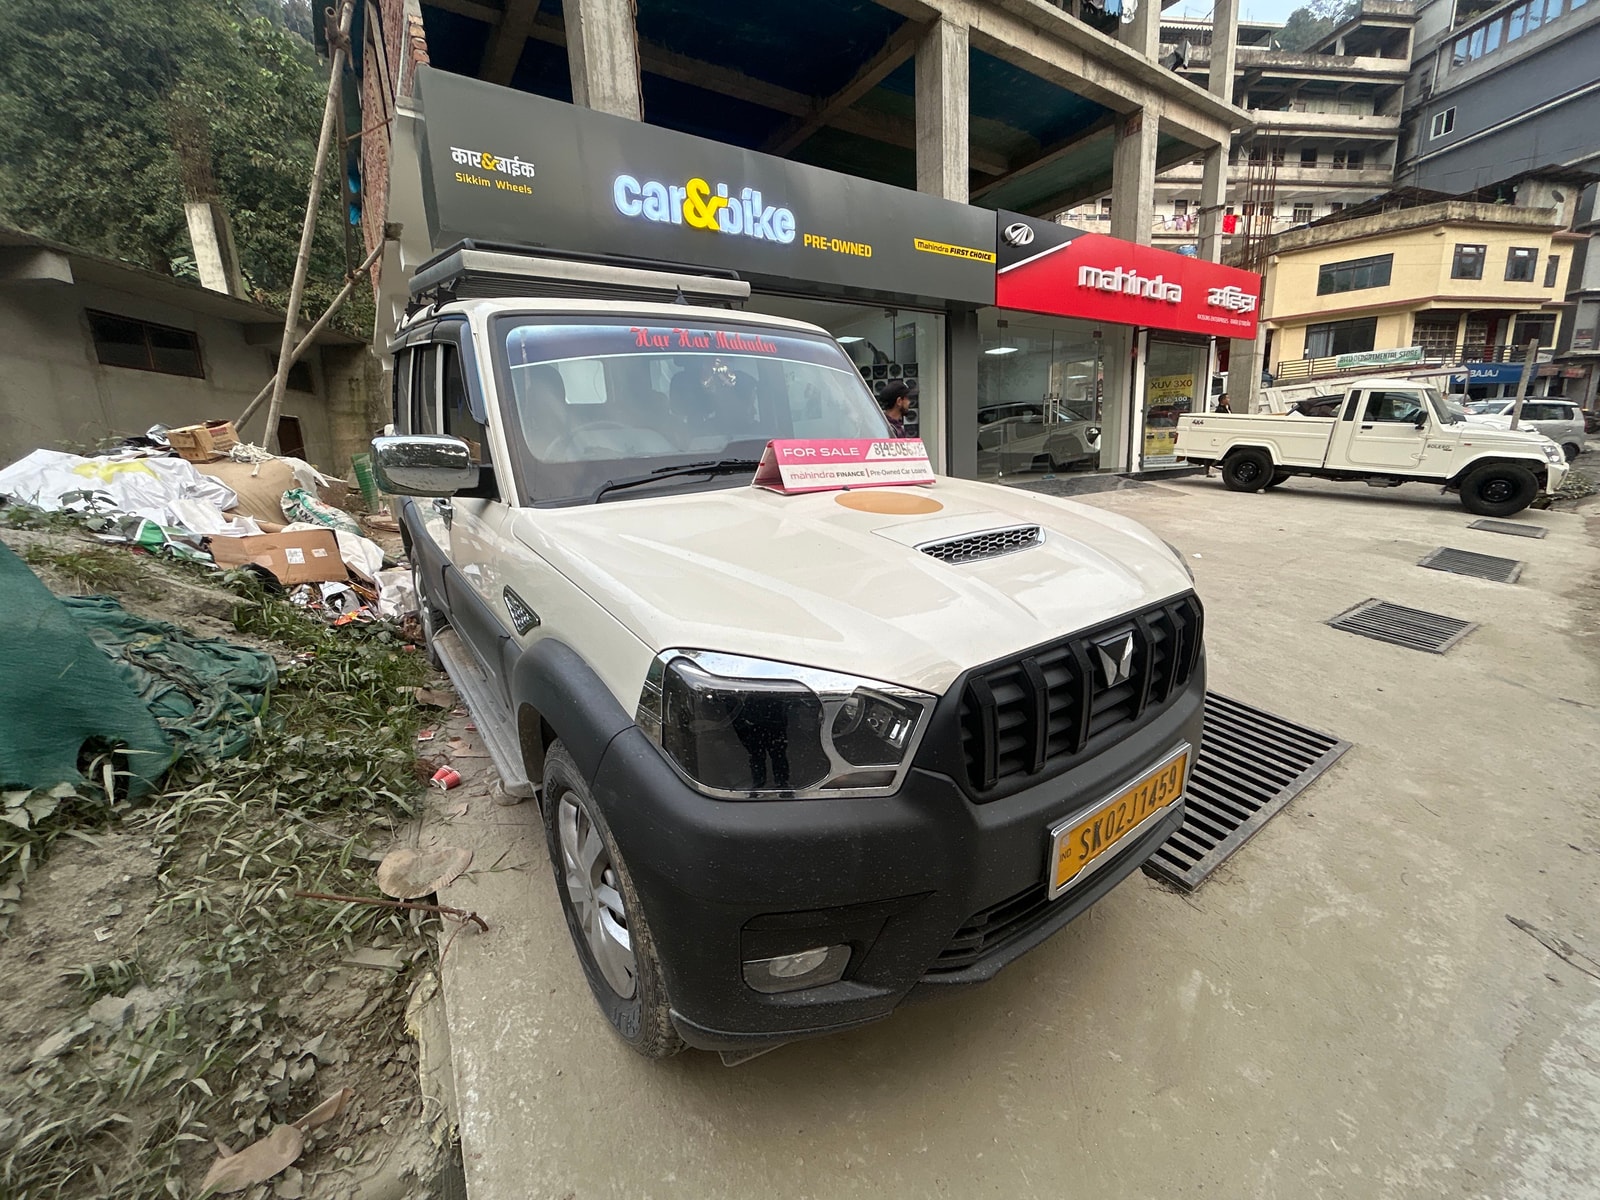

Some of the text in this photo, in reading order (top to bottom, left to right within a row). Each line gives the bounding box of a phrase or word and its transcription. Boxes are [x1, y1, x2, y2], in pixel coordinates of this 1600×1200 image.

[455, 172, 533, 195] Sikkim Wheels
[803, 233, 872, 258] PRE-OWNED
[949, 247, 969, 257] FIRST
[969, 250, 992, 261] CHOICE
[1078, 265, 1182, 304] mahindra
[630, 326, 670, 348] Har
[672, 327, 710, 349] Har
[1399, 349, 1418, 358] STORE
[1470, 369, 1499, 378] BAJAJ
[1151, 380, 1171, 390] XUV
[783, 447, 860, 457] FOR SALE
[790, 471, 836, 480] mahindra
[836, 470, 866, 478] FINANCE
[1078, 765, 1177, 860] SK02J1459
[1059, 847, 1072, 864] IND
